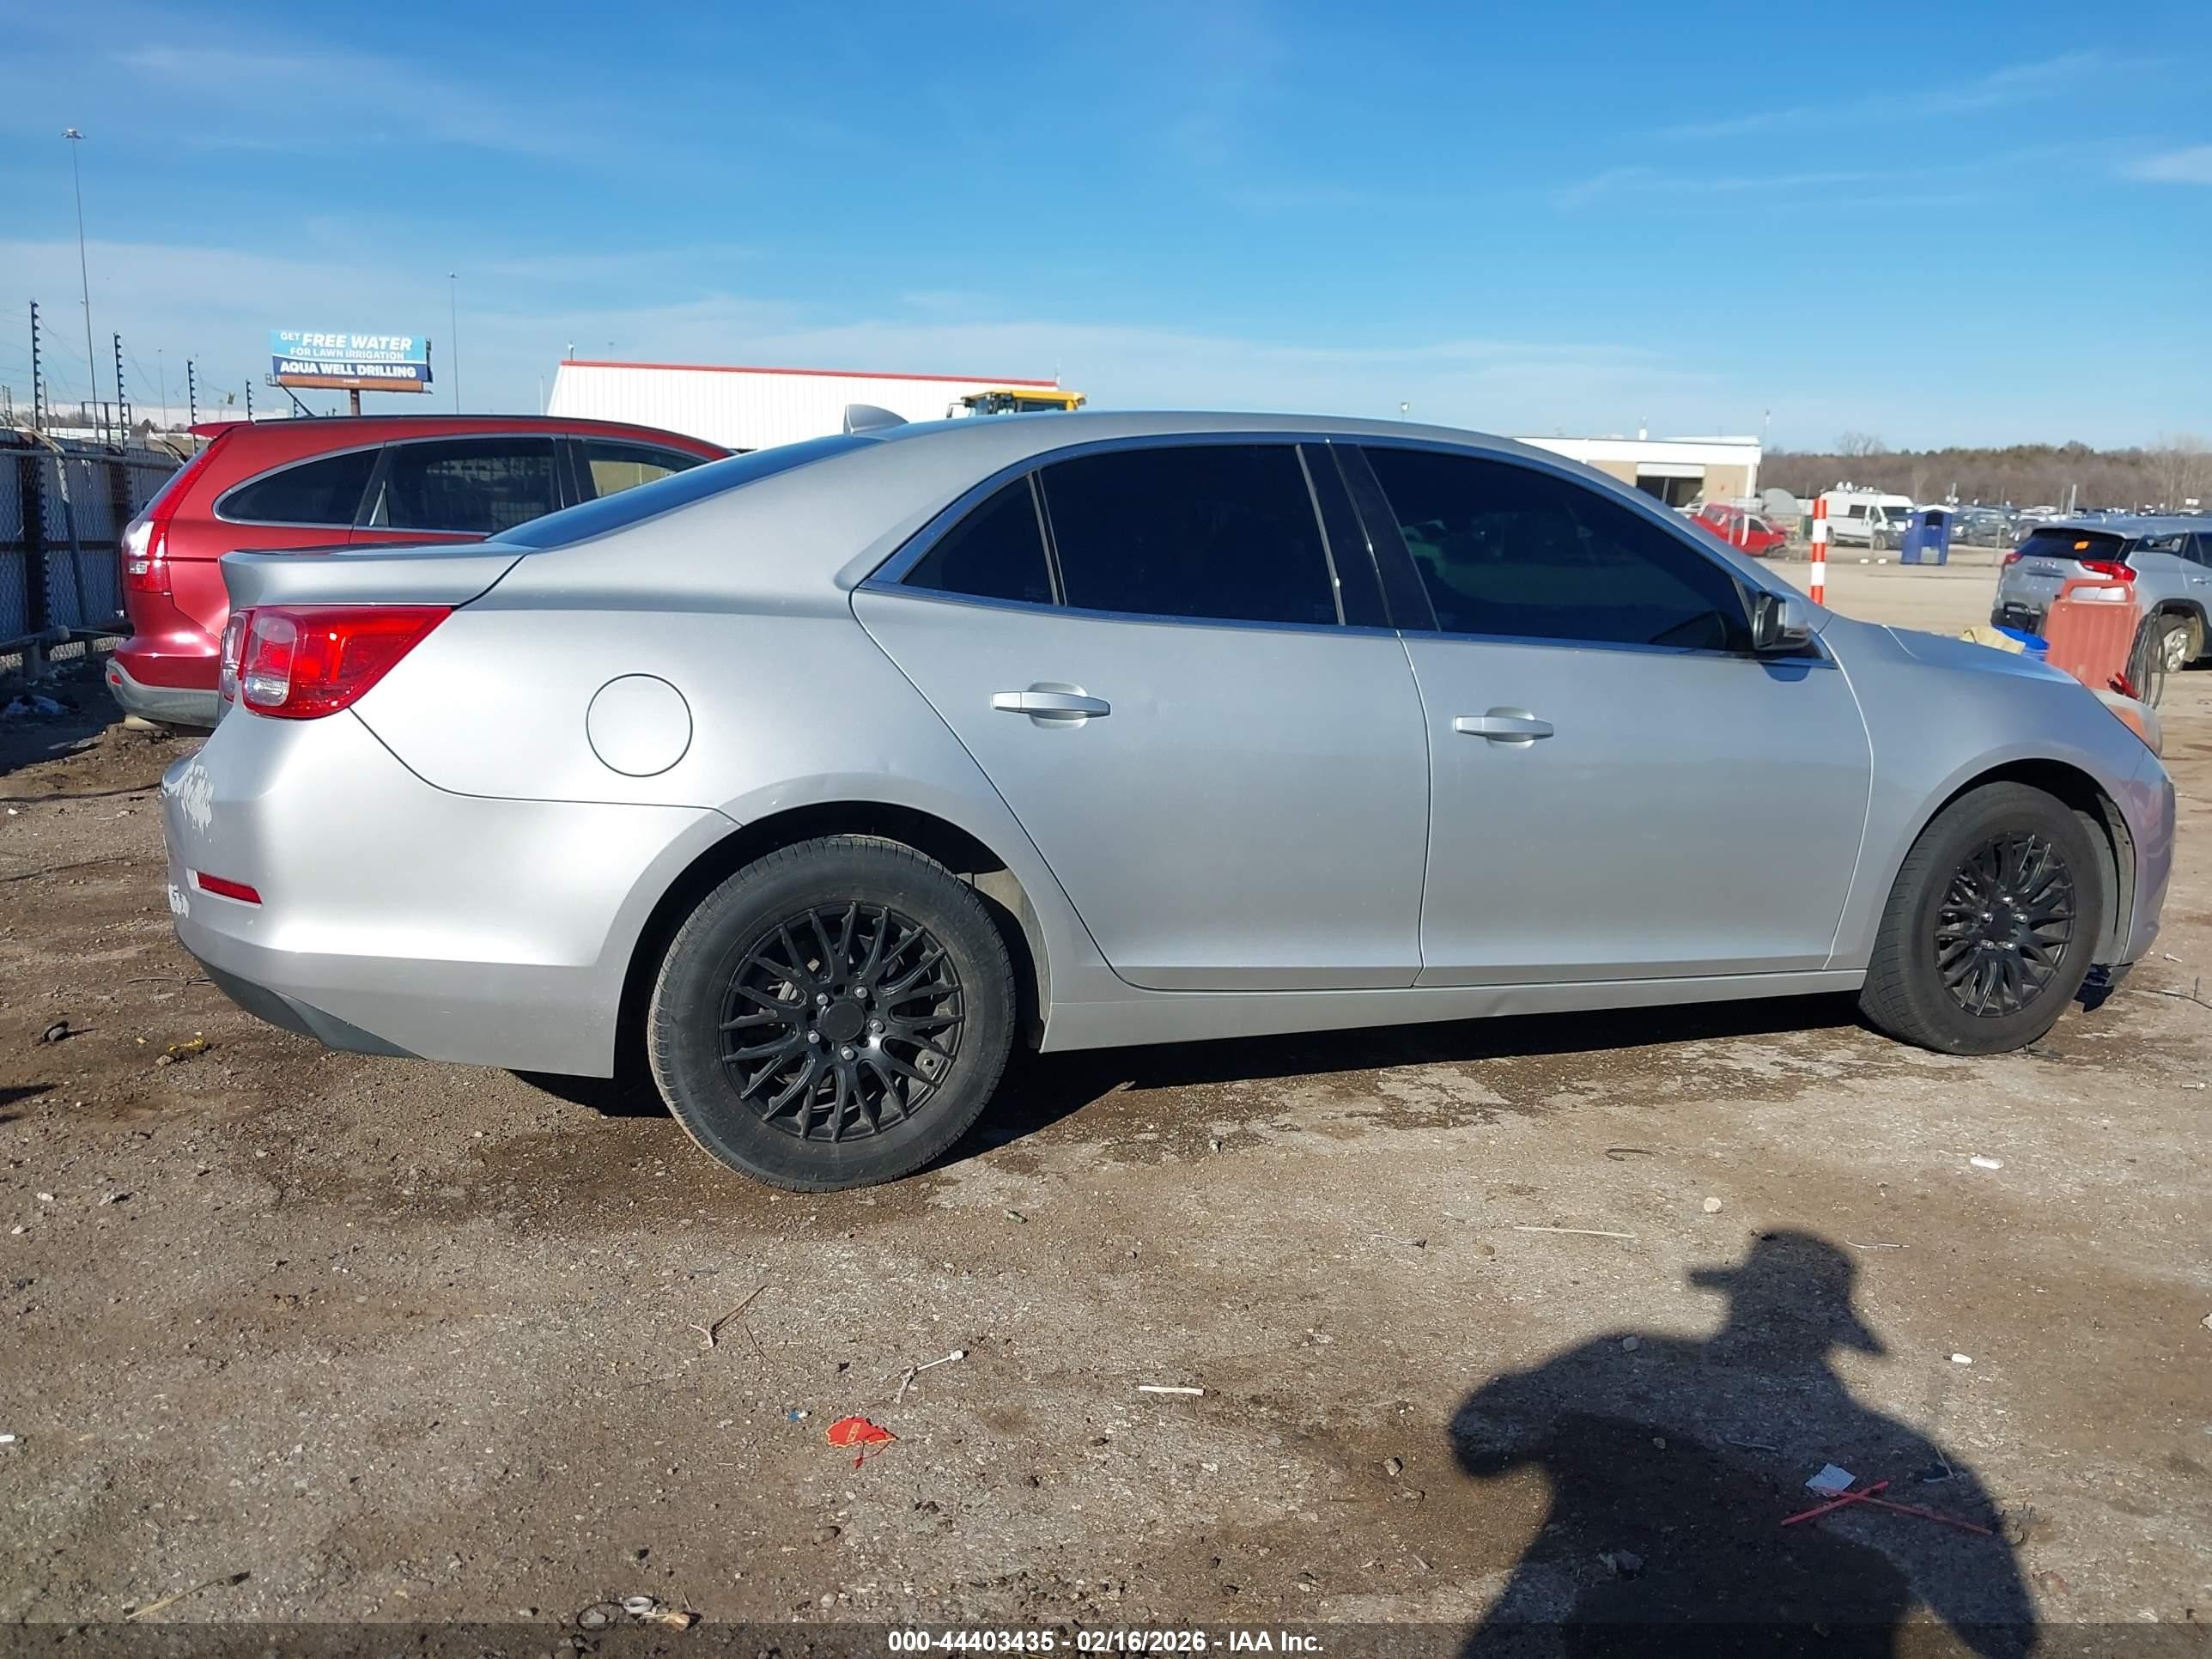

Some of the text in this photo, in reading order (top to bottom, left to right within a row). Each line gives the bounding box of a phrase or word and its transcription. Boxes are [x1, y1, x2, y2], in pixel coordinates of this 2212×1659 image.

[280, 331, 413, 351] GET FREE WATER
[289, 347, 405, 361] FOR LAWN IRRIGATION
[280, 361, 416, 378] AQUA WELL DRILLING
